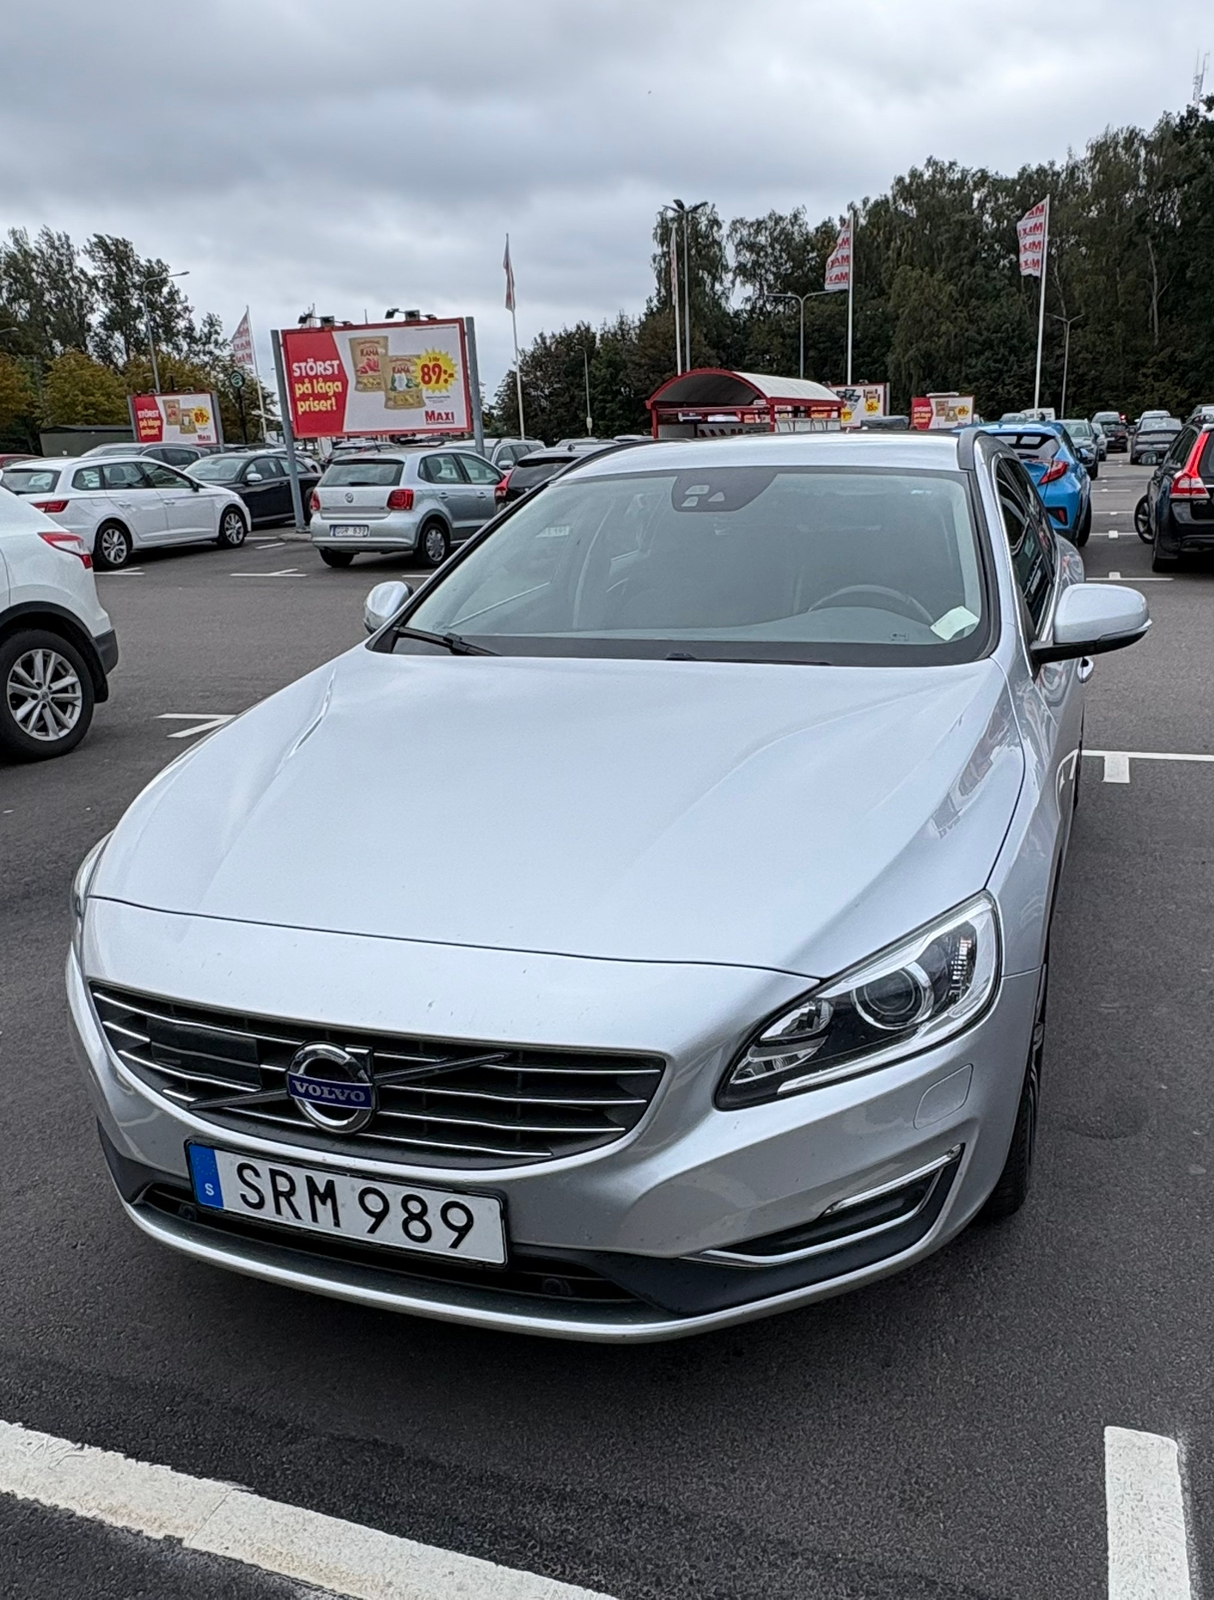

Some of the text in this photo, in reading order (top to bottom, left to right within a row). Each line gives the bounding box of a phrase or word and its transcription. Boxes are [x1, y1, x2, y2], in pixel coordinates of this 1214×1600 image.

[292, 358, 340, 377] STÖRST
[295, 377, 342, 397] på låga
[297, 397, 337, 415] priser!
[425, 410, 454, 422] MAXI
[292, 1080, 365, 1102] VOLVO
[205, 1183, 215, 1196] S
[236, 1162, 475, 1249] SRM 989
